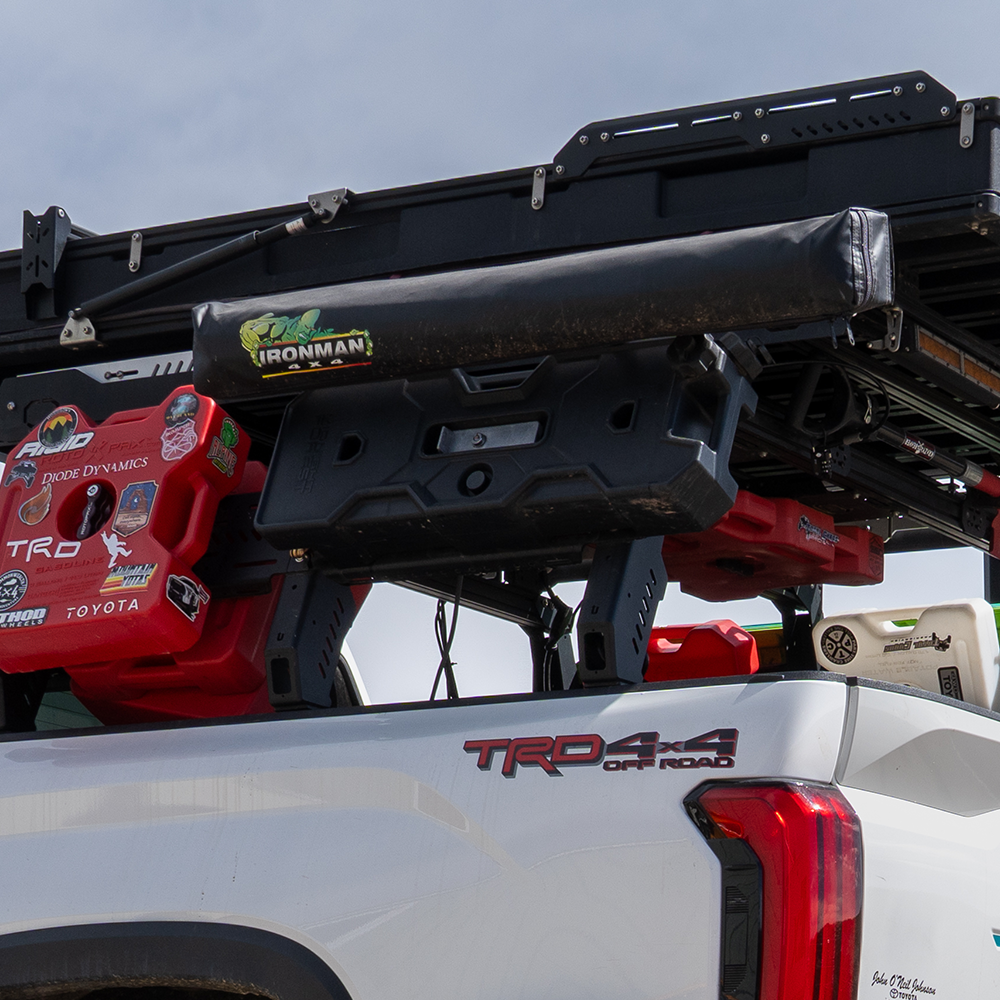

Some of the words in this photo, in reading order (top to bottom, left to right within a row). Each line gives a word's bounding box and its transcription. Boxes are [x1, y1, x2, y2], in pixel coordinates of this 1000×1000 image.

[259, 338, 365, 366] IRONMAN
[41, 468, 80, 485] DIODE
[83, 457, 149, 477] DYNAMICS
[6, 536, 82, 563] TRD
[35, 556, 106, 574] GASOLINE
[66, 598, 139, 619] TOYOTA
[463, 733, 606, 779] TRD
[605, 728, 739, 760] 4x4
[602, 758, 656, 772] OFF
[659, 756, 736, 770] ROAD
[871, 970, 888, 987] John
[889, 974, 912, 990] O'Neil
[911, 978, 937, 995] Johnson
[898, 991, 918, 1000] TOYOTA
